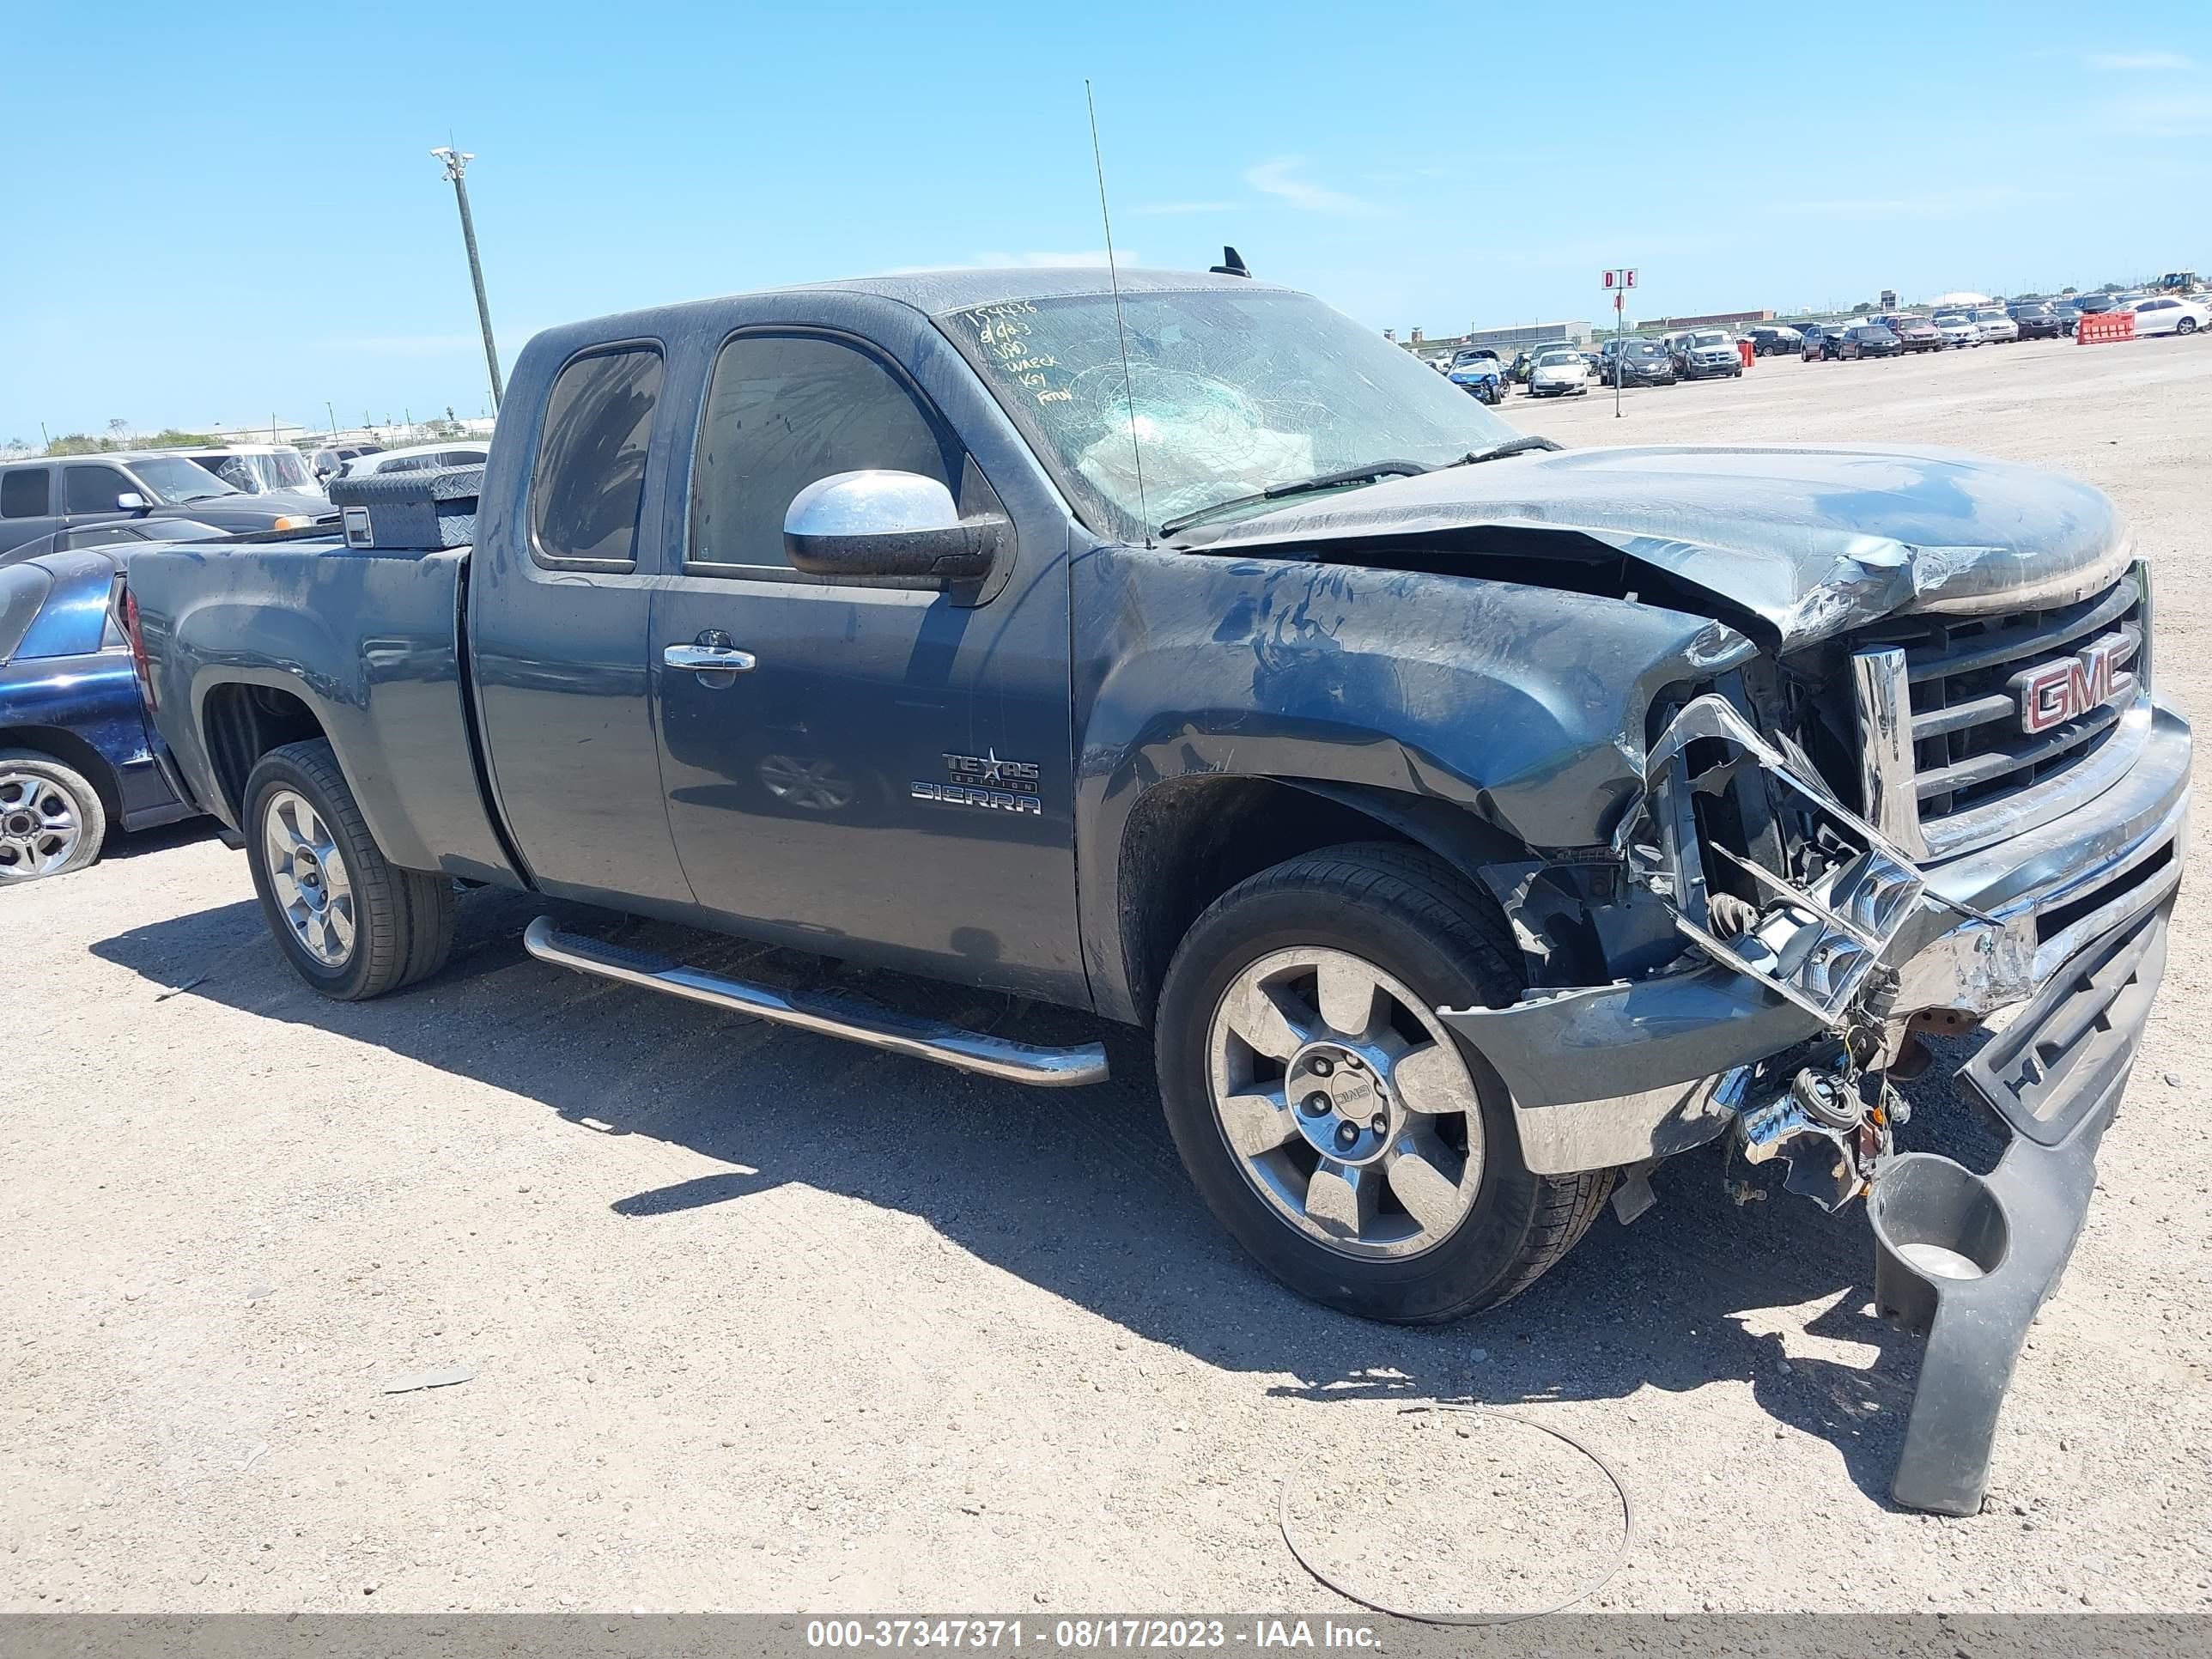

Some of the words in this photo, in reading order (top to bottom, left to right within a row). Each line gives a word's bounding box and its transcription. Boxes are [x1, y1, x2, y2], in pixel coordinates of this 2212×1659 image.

[1605, 272, 1613, 287] D
[1627, 271, 1633, 286] E
[964, 301, 1037, 328] 154436
[980, 321, 1032, 345] 8/6/23
[2023, 633, 2133, 733] GMC
[941, 747, 1039, 781] TEXAS
[955, 775, 1032, 791] EDITION
[910, 781, 1042, 816] SIERRA
[1333, 1085, 1371, 1105] GMC
